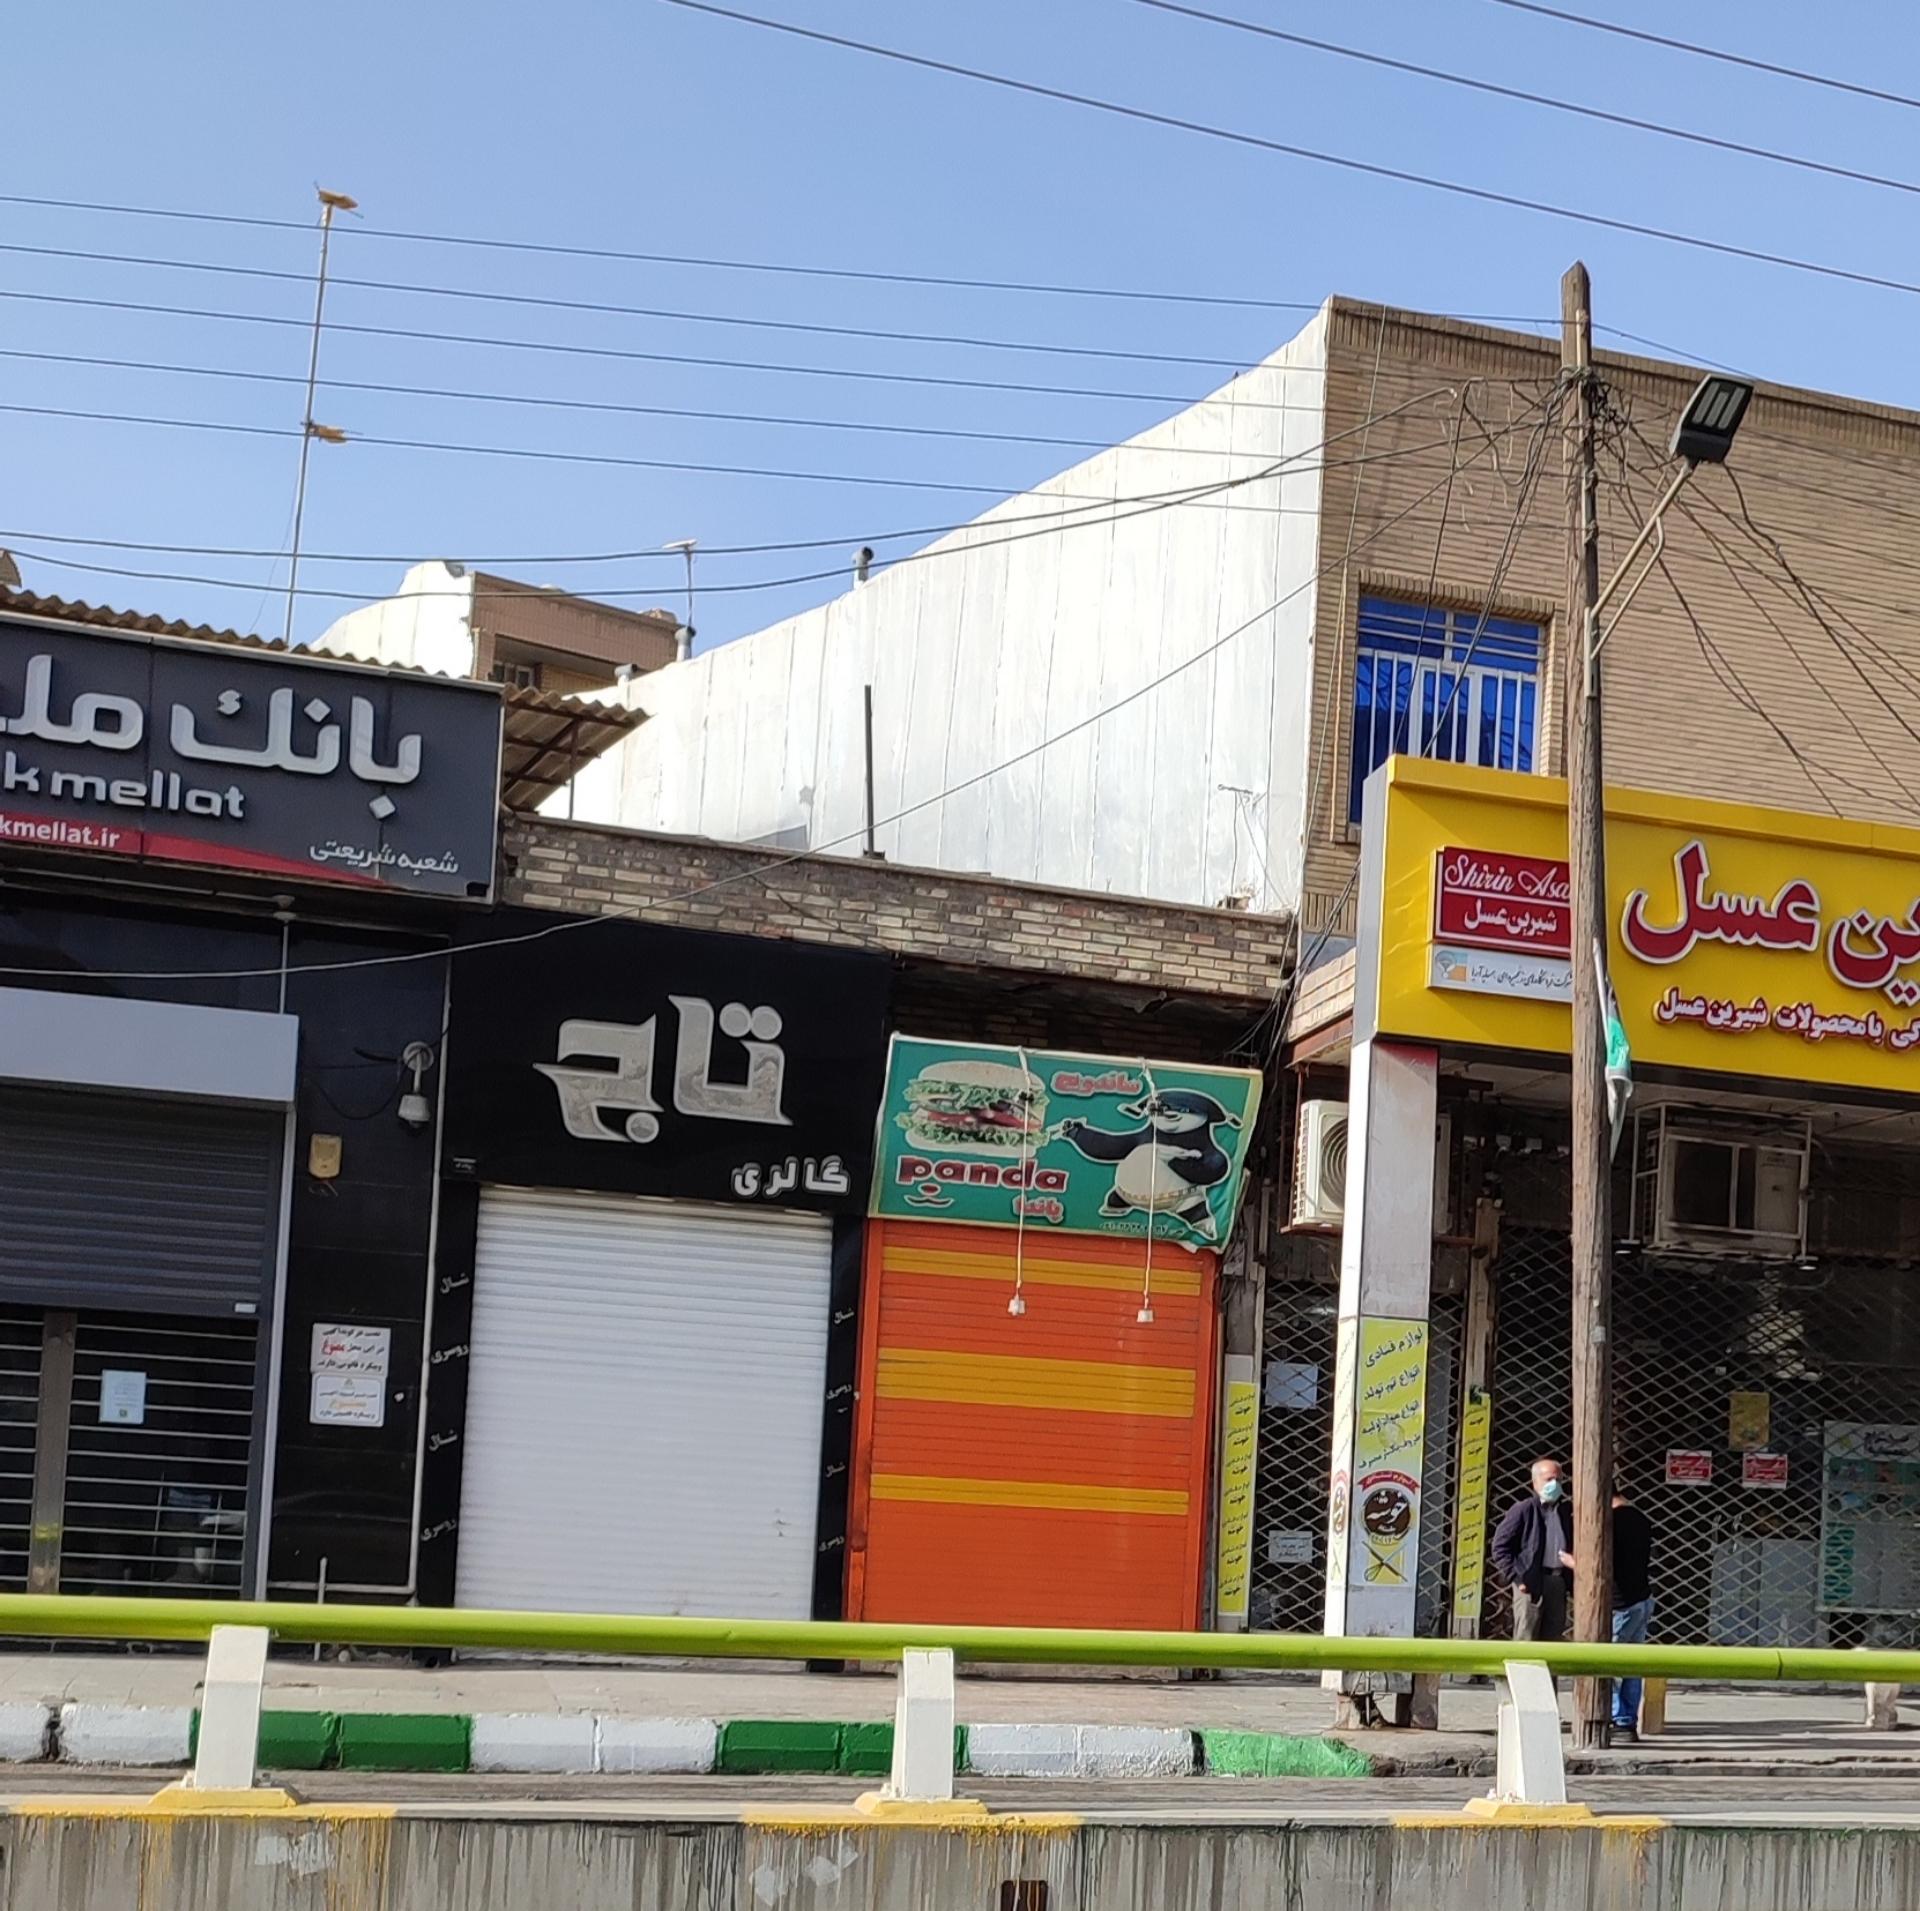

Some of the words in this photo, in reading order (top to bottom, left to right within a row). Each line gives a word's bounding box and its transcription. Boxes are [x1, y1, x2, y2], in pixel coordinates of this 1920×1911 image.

[170, 687, 421, 820] بانک
[51, 769, 245, 819] mellat
[310, 840, 397, 867] شریعتی
[397, 851, 459, 876] شعبه
[1444, 854, 1514, 892] Shirin
[1518, 866, 1571, 899] Asa
[1464, 899, 1507, 929] عسل
[1621, 840, 1820, 964] عسل
[1505, 908, 1558, 937] شیرین
[1655, 987, 1706, 1024] عسل
[1705, 998, 1770, 1031] شیرین
[1772, 1003, 1867, 1043] محصولات
[532, 993, 794, 1144] تاج
[1052, 1072, 1142, 1096] ساندویچ
[731, 1155, 850, 1198] گالری
[897, 1156, 1068, 1192] panda
[1013, 1195, 1064, 1223] پاندا
[440, 1272, 470, 1294] شال
[1365, 1339, 1396, 1368] قنادی
[1398, 1326, 1423, 1351] لوازم
[431, 1344, 469, 1364] روسری
[1399, 1364, 1421, 1387] انواع
